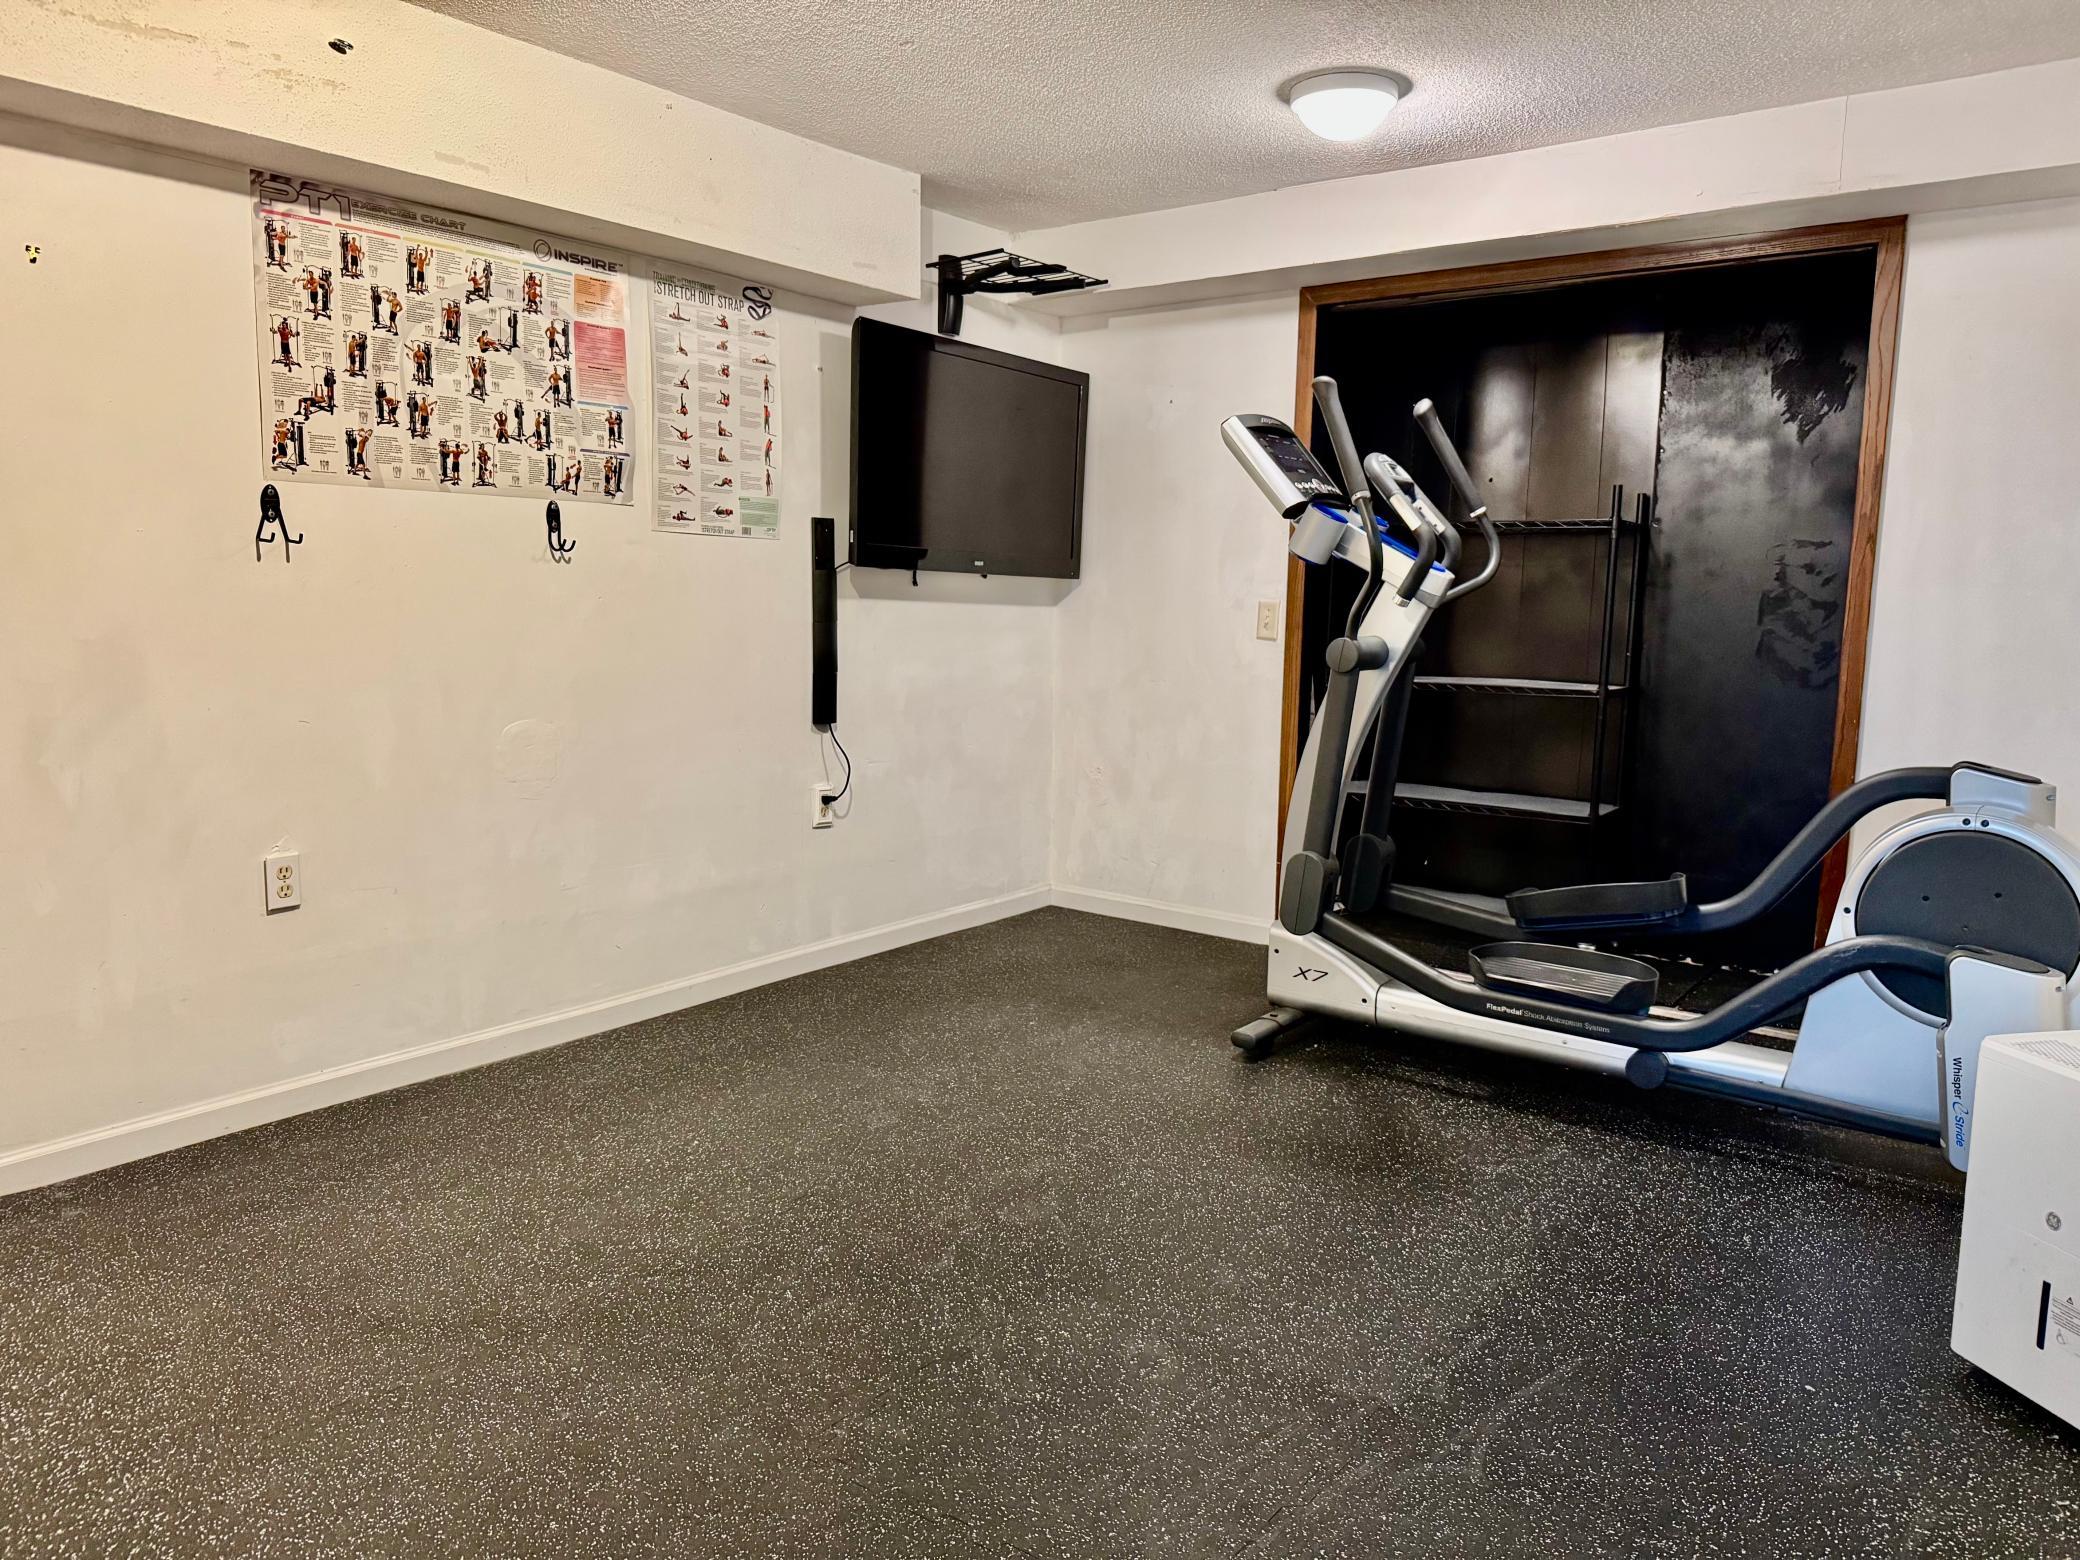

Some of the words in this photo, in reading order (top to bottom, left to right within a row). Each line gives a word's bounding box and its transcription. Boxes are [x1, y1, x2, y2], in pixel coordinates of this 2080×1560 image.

[259, 179, 351, 221] PT1
[351, 199, 418, 220] EXERCISE
[420, 214, 467, 231] CHART
[553, 249, 618, 272] INSPIRE
[656, 280, 696, 303] STRETCH
[698, 290, 714, 307] OUT
[718, 295, 744, 312] STRAP
[1292, 966, 1329, 982] X7
[1486, 1003, 1522, 1016] FlexPedal
[1523, 1010, 1545, 1021] Shock
[1952, 1057, 1963, 1100] Whisper
[1954, 1116, 1966, 1148] Stride
